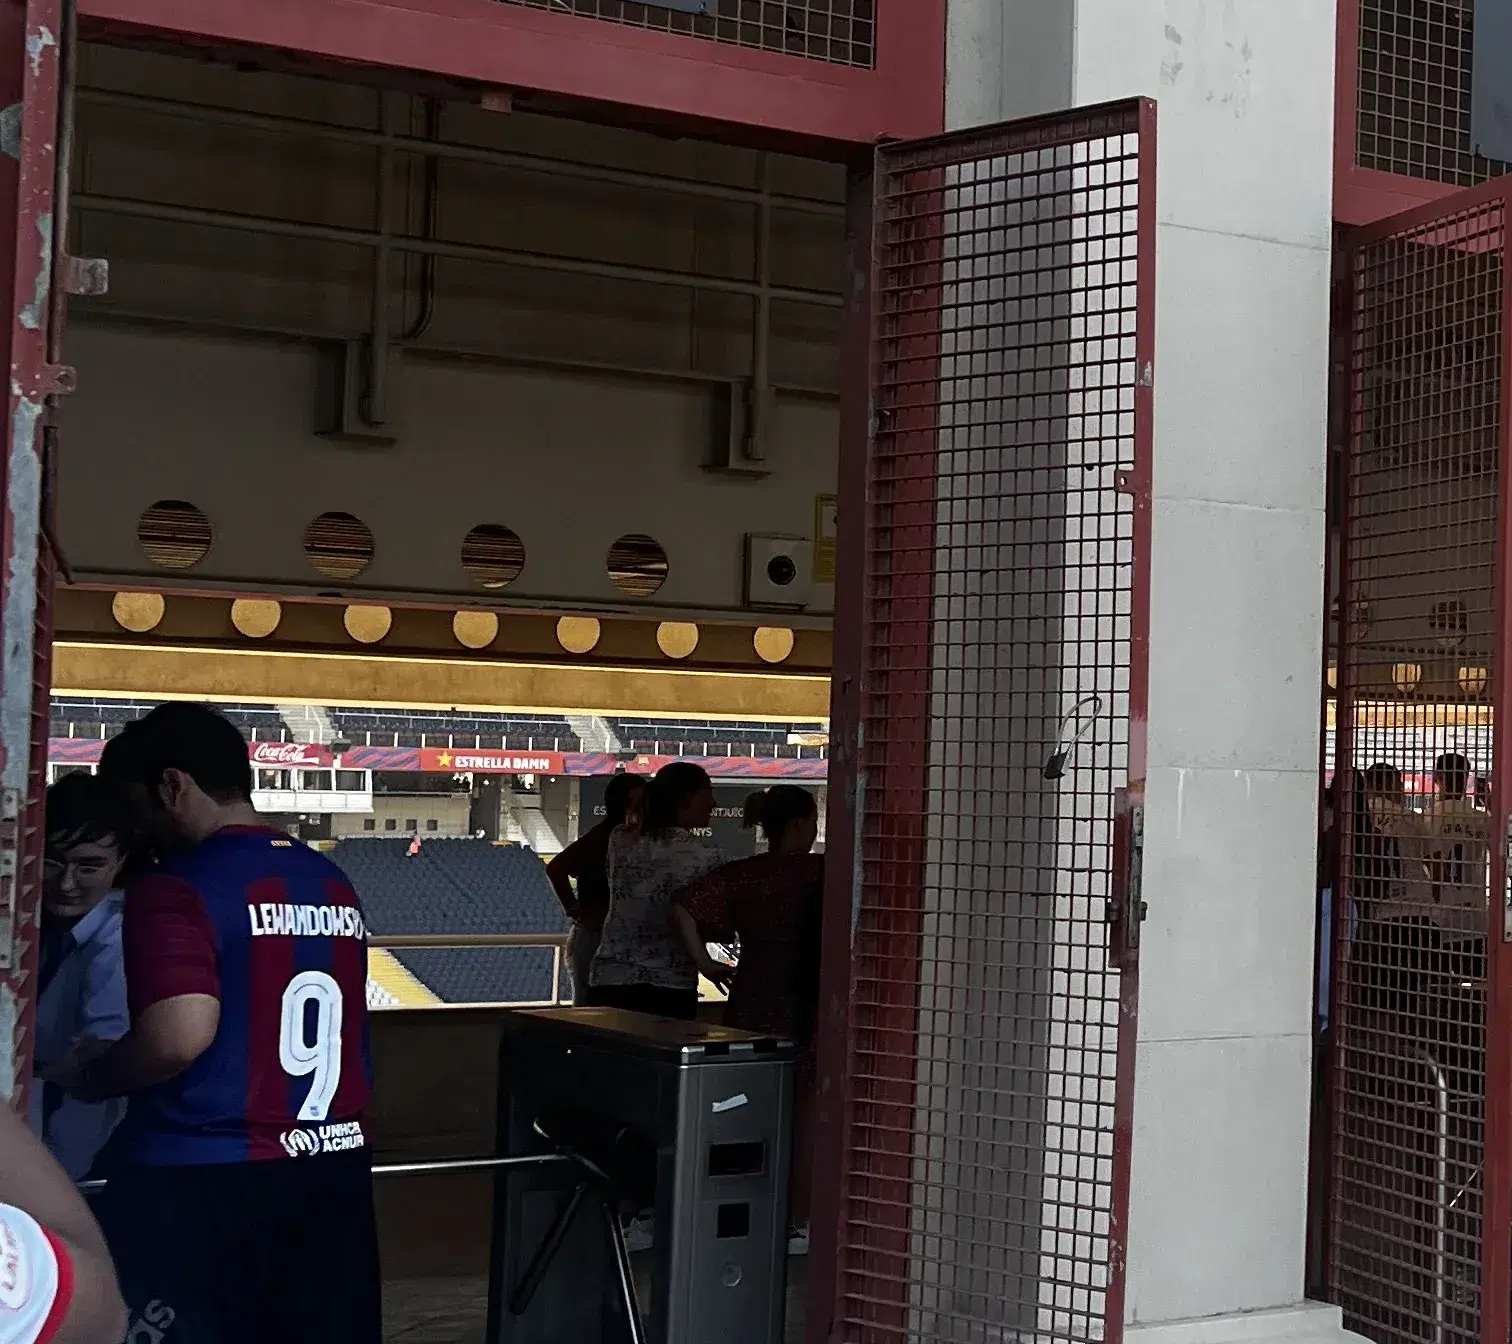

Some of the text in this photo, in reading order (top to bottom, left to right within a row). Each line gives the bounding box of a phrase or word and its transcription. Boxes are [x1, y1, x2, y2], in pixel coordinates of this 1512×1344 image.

[254, 743, 312, 762] Coca-Cola
[454, 756, 550, 770] ESTRELLA DAMM
[248, 903, 364, 940] LEWANDOWS
[279, 970, 343, 1121] 9
[319, 1121, 361, 1140] UNHCR
[322, 1134, 364, 1152] ACNUR
